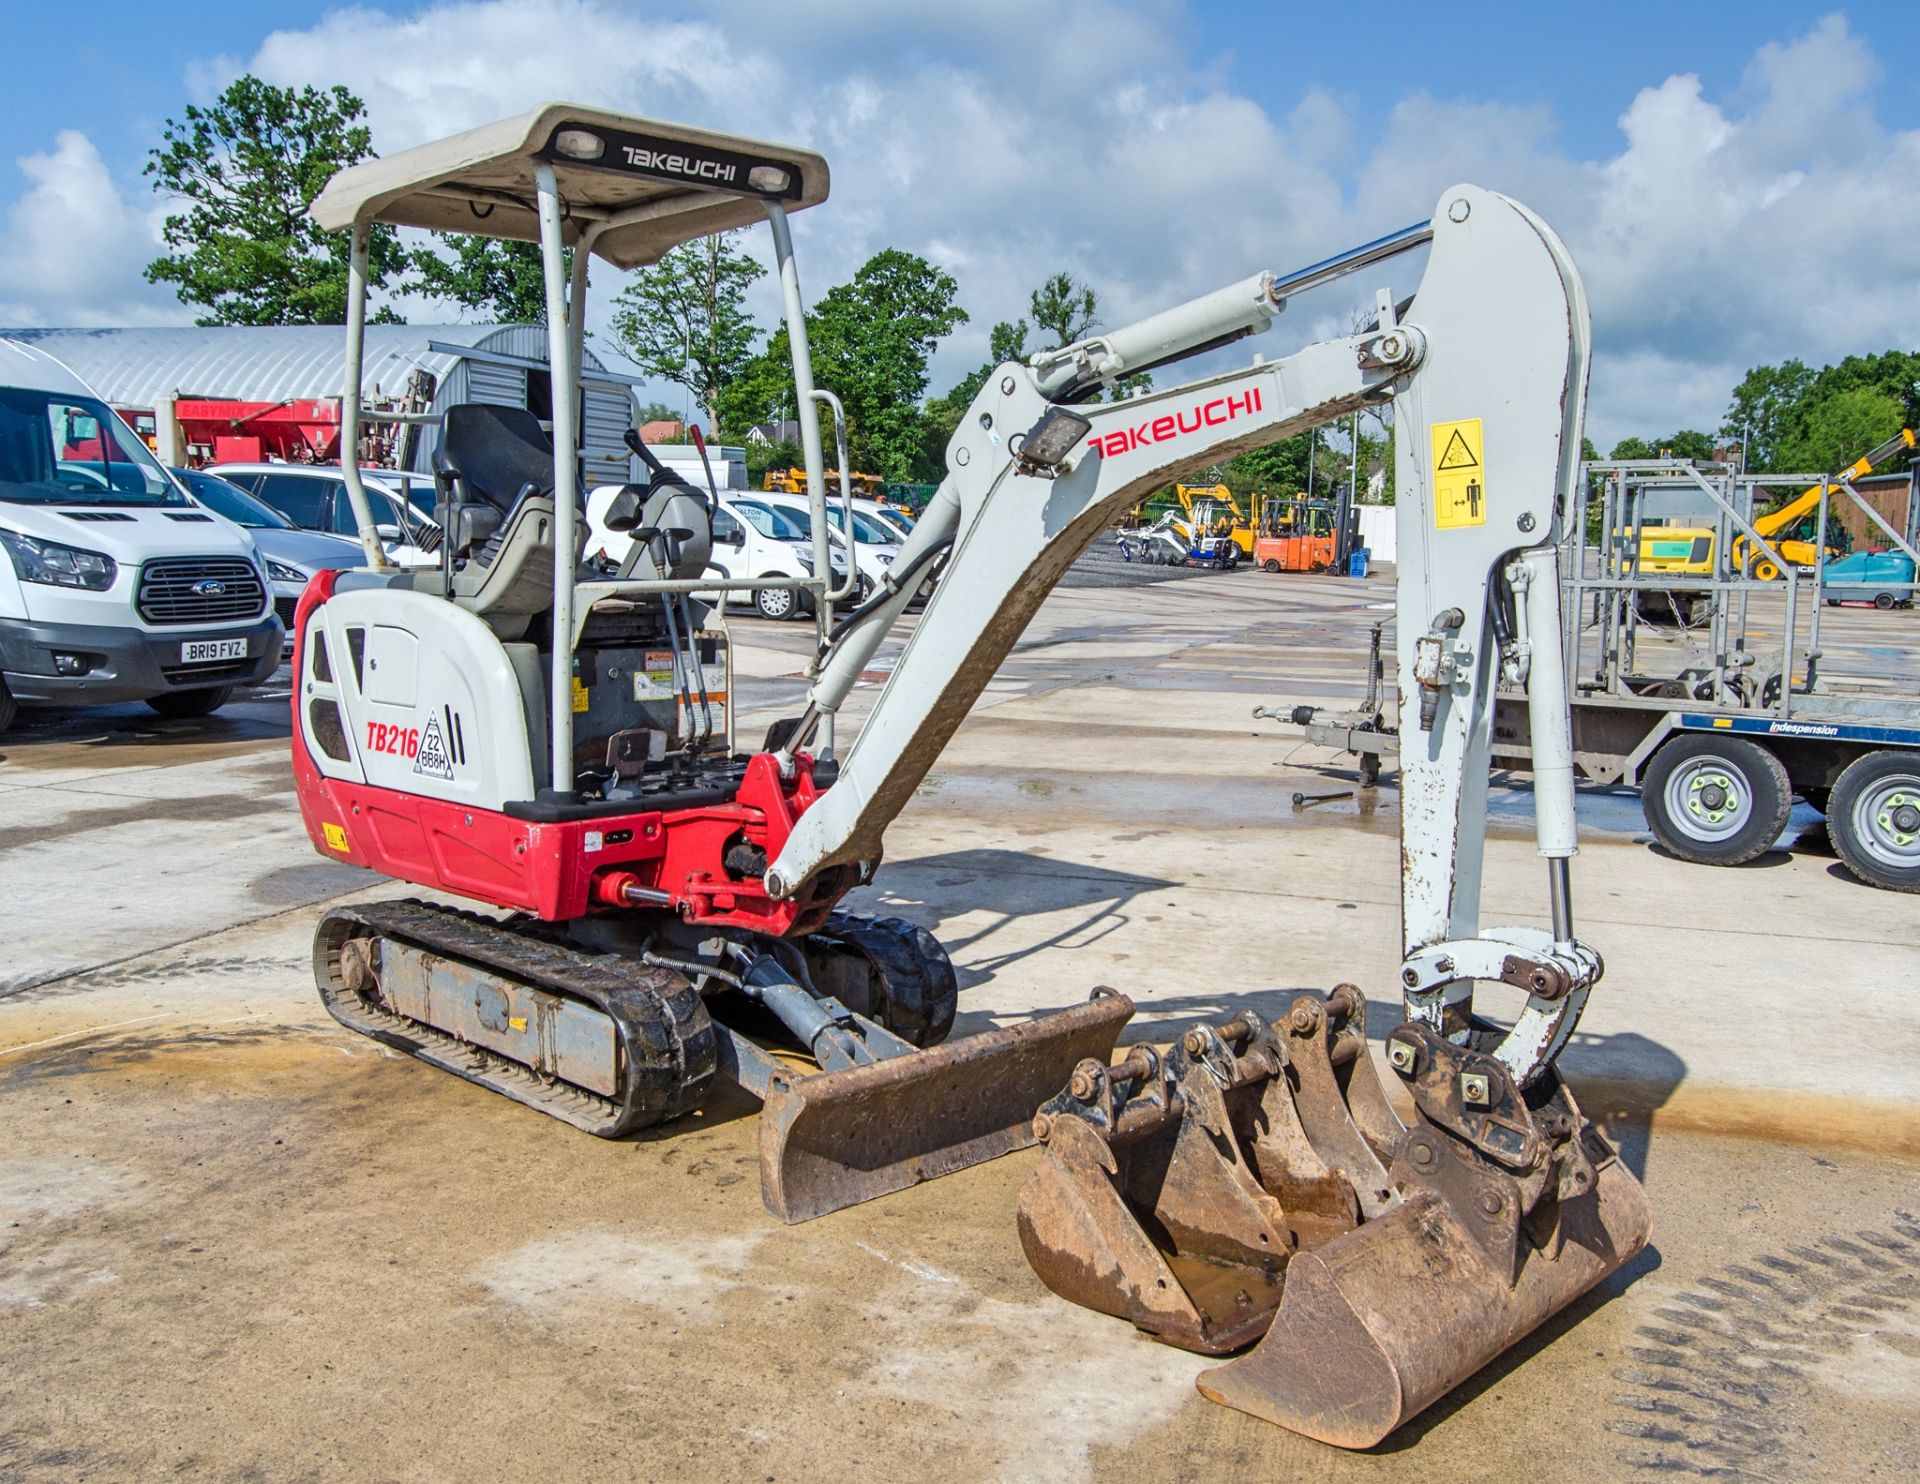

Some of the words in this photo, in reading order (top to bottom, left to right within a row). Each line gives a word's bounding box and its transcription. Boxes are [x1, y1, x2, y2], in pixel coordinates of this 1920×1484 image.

[182, 404, 245, 418] EASYMIX
[189, 643, 217, 660] BR19
[220, 641, 241, 657] FVZ
[1768, 721, 1839, 736] indespension
[367, 721, 419, 759] TB216
[427, 734, 440, 752] 22
[421, 750, 446, 771] BB8H
